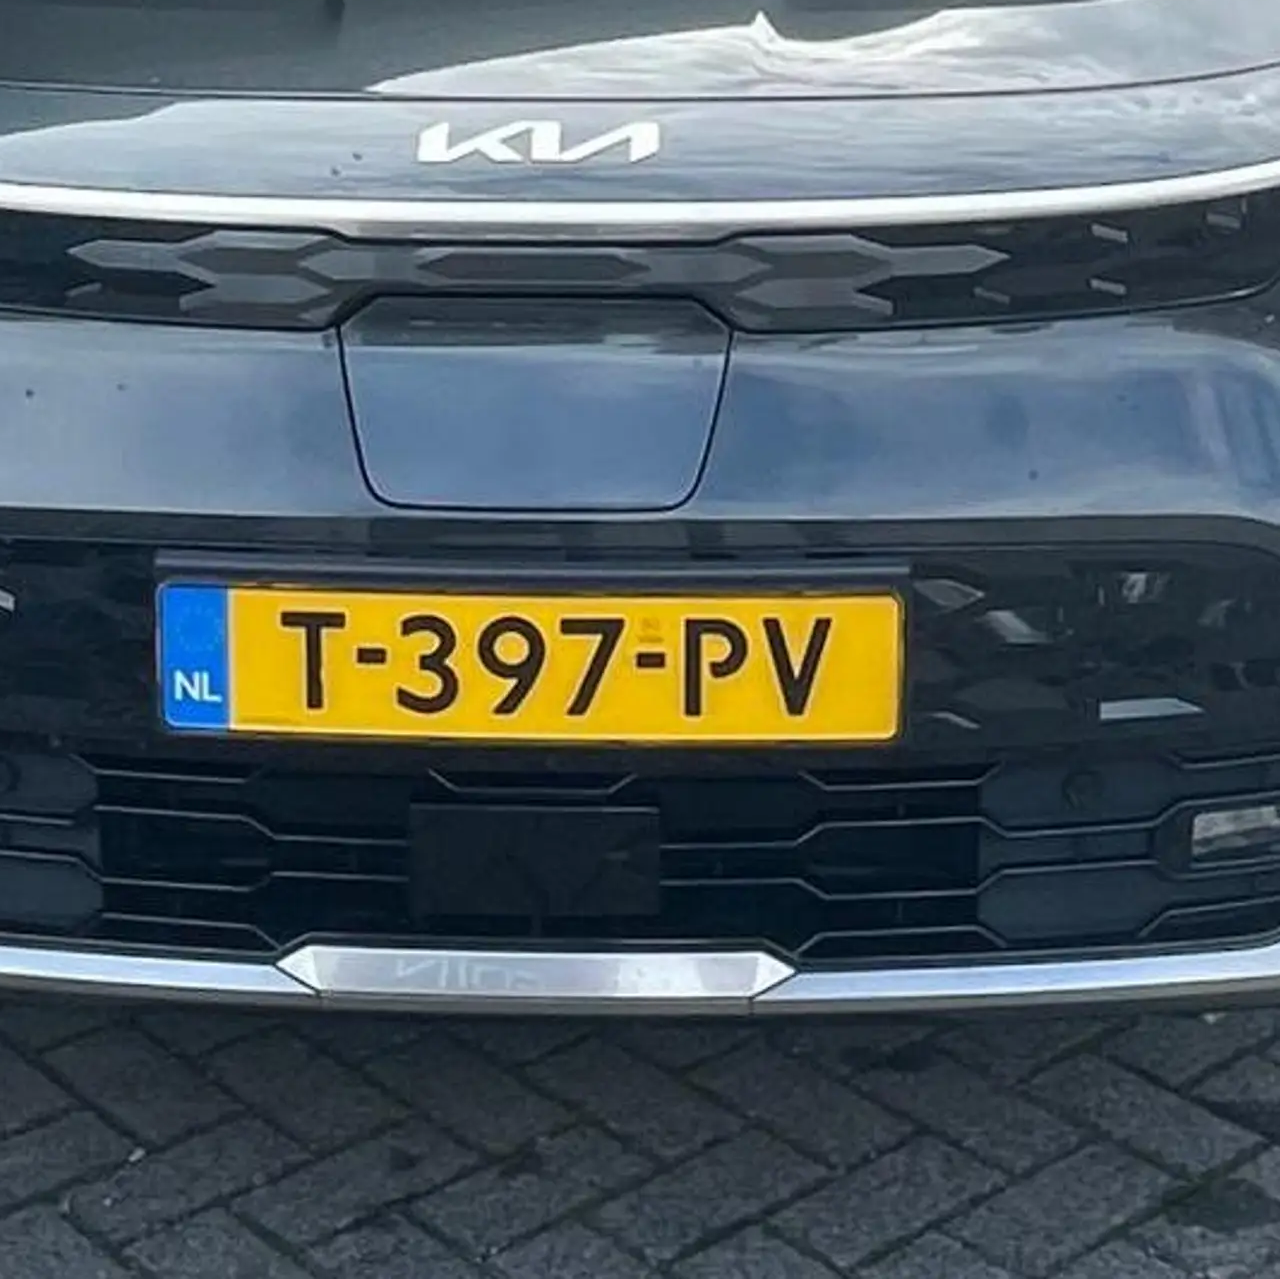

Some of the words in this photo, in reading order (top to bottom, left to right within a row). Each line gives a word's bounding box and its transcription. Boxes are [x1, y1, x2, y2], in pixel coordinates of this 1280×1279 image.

[417, 120, 660, 163] KIA
[280, 610, 833, 717] T-397-PV
[174, 669, 223, 702] NL
